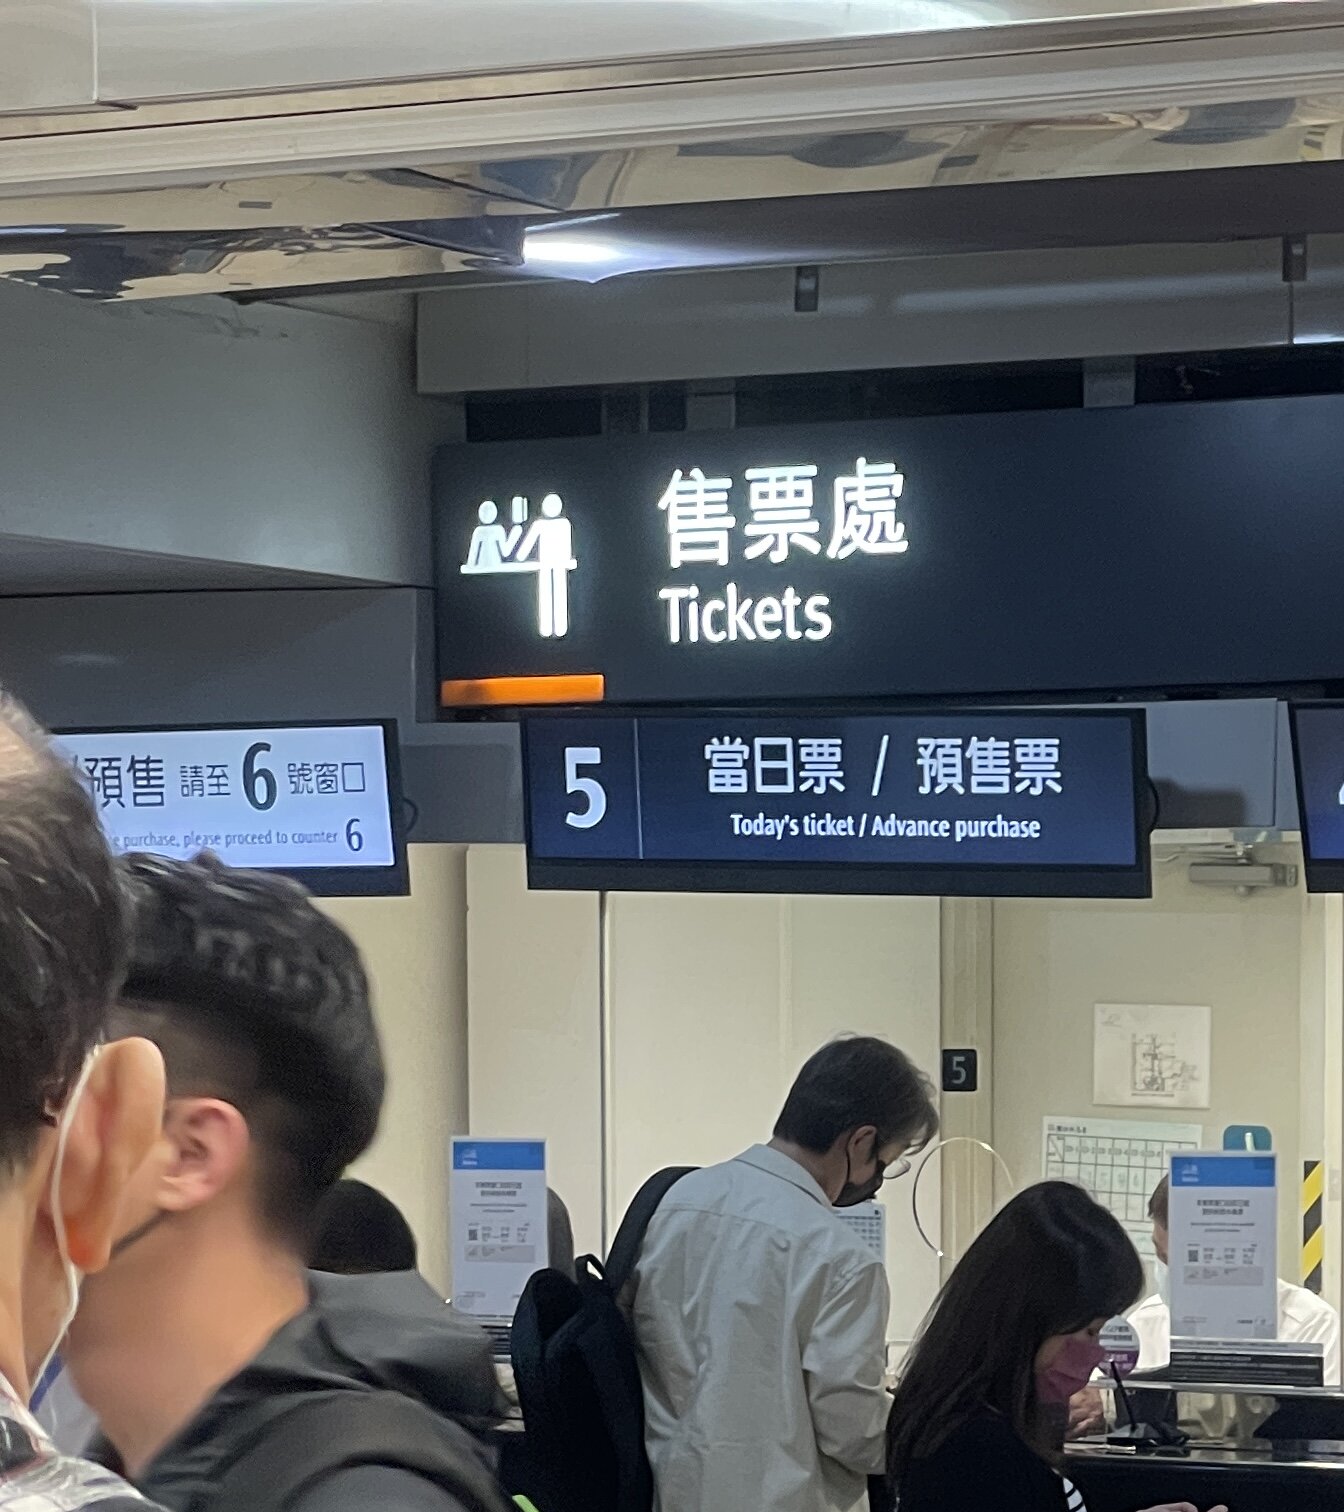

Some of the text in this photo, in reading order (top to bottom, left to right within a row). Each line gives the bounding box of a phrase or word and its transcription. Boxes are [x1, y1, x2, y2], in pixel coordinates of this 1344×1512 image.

[657, 456, 909, 569] 售票處
[658, 581, 832, 644] Tickets
[73, 742, 366, 812] 預售 請至 6 號窗口
[564, 747, 607, 829] 5
[704, 735, 1063, 796] 當日票 預售票
[122, 818, 363, 856] purchase, please proceed to counter 6
[729, 812, 1041, 842] Today's ticket Advance purchase
[952, 1055, 967, 1084] 5
